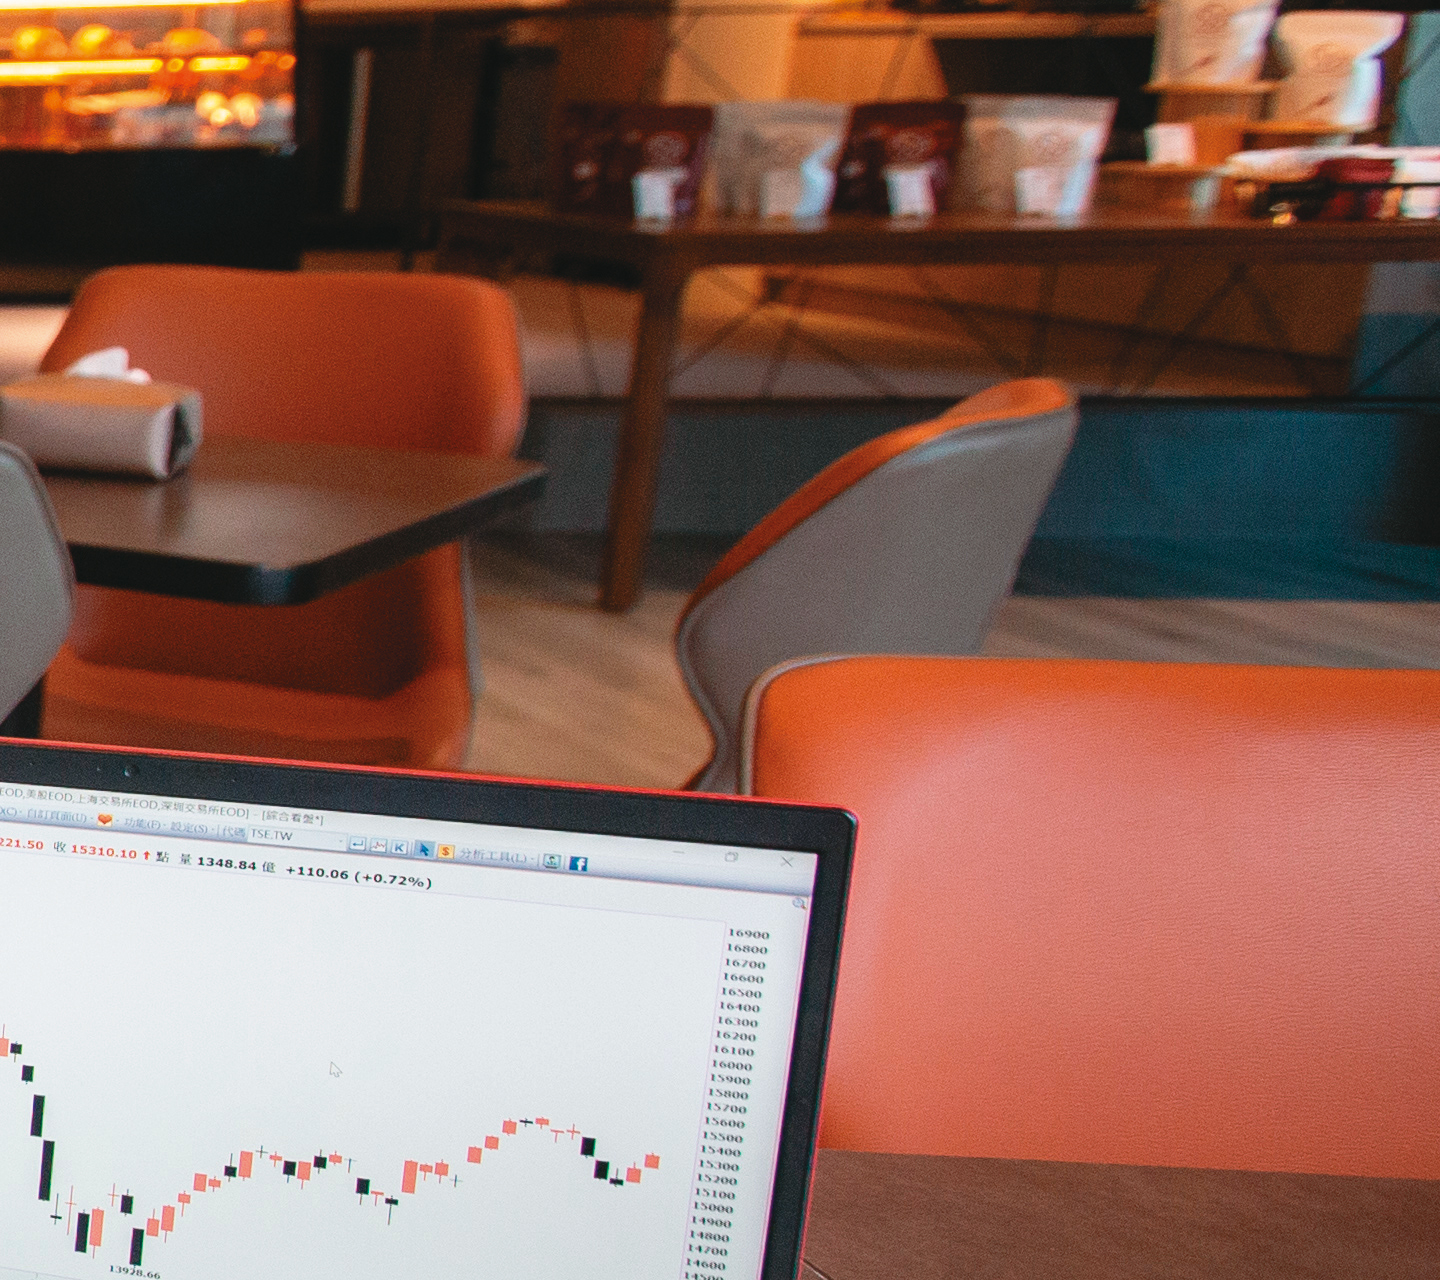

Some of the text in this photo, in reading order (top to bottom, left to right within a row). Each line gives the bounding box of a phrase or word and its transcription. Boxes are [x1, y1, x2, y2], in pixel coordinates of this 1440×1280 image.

[250, 827, 294, 843] TSE.TW
[70, 843, 138, 860] 15310.10
[196, 855, 257, 873] 1348.84
[284, 863, 350, 883] +110.06
[353, 869, 434, 891] (+0.72%)
[727, 943, 769, 955] 16800
[720, 1001, 761, 1013] 16400
[712, 1059, 753, 1071] 16000
[705, 1116, 746, 1129] 15600
[697, 1173, 738, 1186] 15200
[690, 1230, 730, 1243] 14800
[108, 1263, 162, 1280] 13928.66
